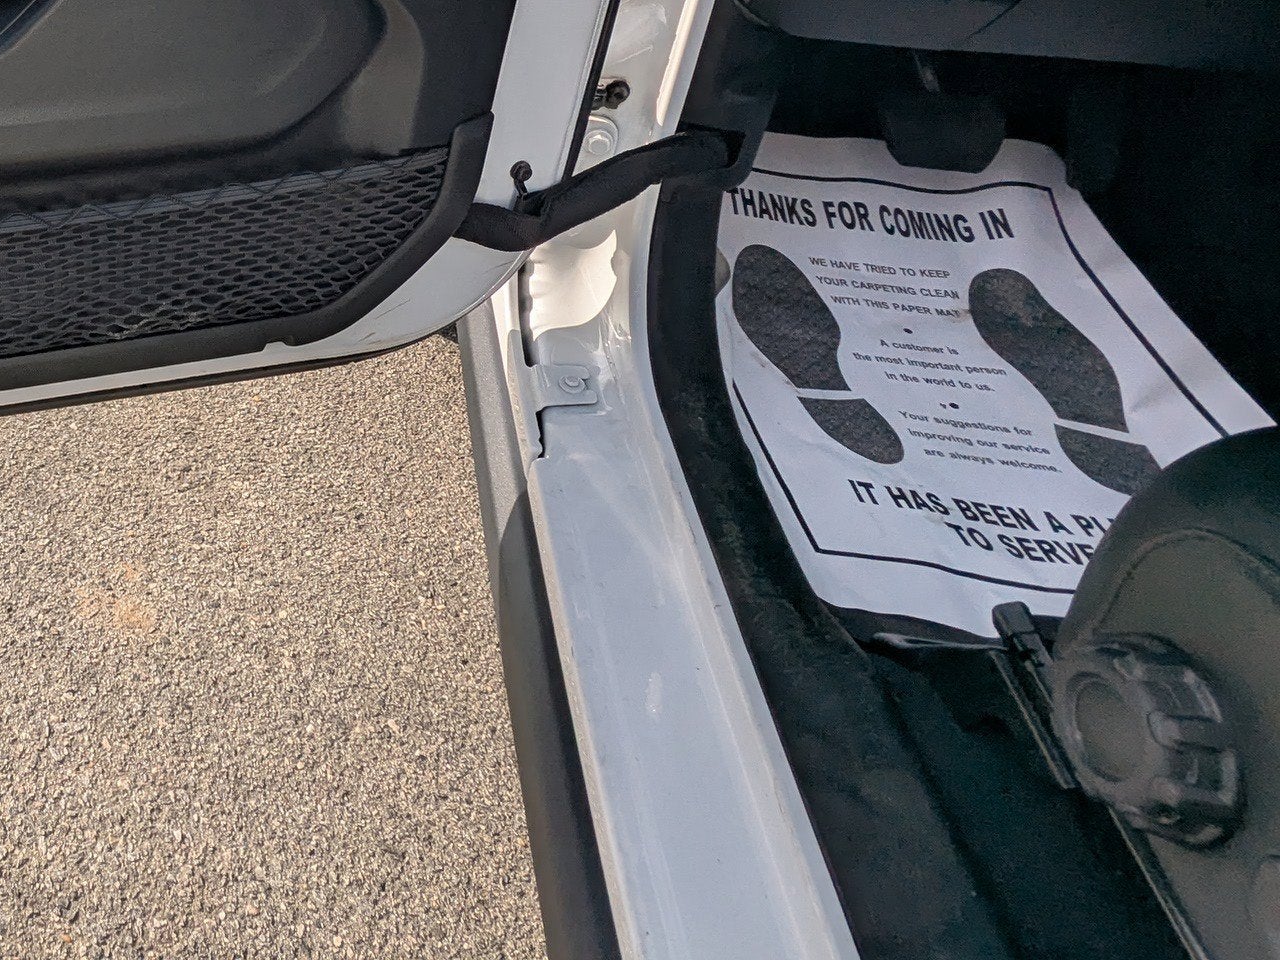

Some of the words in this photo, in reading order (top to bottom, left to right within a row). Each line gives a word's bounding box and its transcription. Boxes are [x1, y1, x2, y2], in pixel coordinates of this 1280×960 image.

[726, 188, 817, 227] THANKS
[822, 201, 875, 232] FOR
[879, 205, 975, 243] COMING
[979, 208, 1015, 240] IN
[808, 257, 828, 267] WE
[830, 259, 860, 271] HAVE
[863, 263, 896, 275] TRIED
[899, 267, 916, 277] TO
[920, 269, 950, 279] KEEP
[816, 275, 848, 287] YOUR
[851, 280, 917, 296] CARPETING
[920, 288, 960, 300] CLEAN
[830, 295, 861, 306] WITH
[863, 298, 890, 310] THIS
[893, 303, 932, 315] PAPER
[935, 308, 960, 318] MAT
[880, 339, 890, 348] A
[892, 342, 944, 354] customer
[946, 346, 960, 356] is
[852, 352, 872, 362] the
[874, 355, 904, 366] most
[907, 357, 963, 372] important
[965, 366, 1007, 376] person
[884, 371, 897, 381] in
[899, 373, 920, 383] the
[922, 376, 956, 388] world
[958, 380, 972, 390] to
[898, 410, 929, 422] Your
[933, 416, 1011, 434] suggestions
[1013, 427, 1032, 436] for
[907, 428, 973, 446] improving
[976, 439, 998, 448] our
[1002, 442, 1051, 455] service
[924, 448, 945, 457] are
[948, 450, 995, 465] always
[998, 459, 1063, 473] welcome.
[848, 479, 879, 505] IT
[884, 485, 950, 515] HAS
[951, 497, 1040, 532] BEEN
[1043, 511, 1075, 536] A
[944, 521, 993, 551] TO
[997, 534, 1094, 565] SERVE
